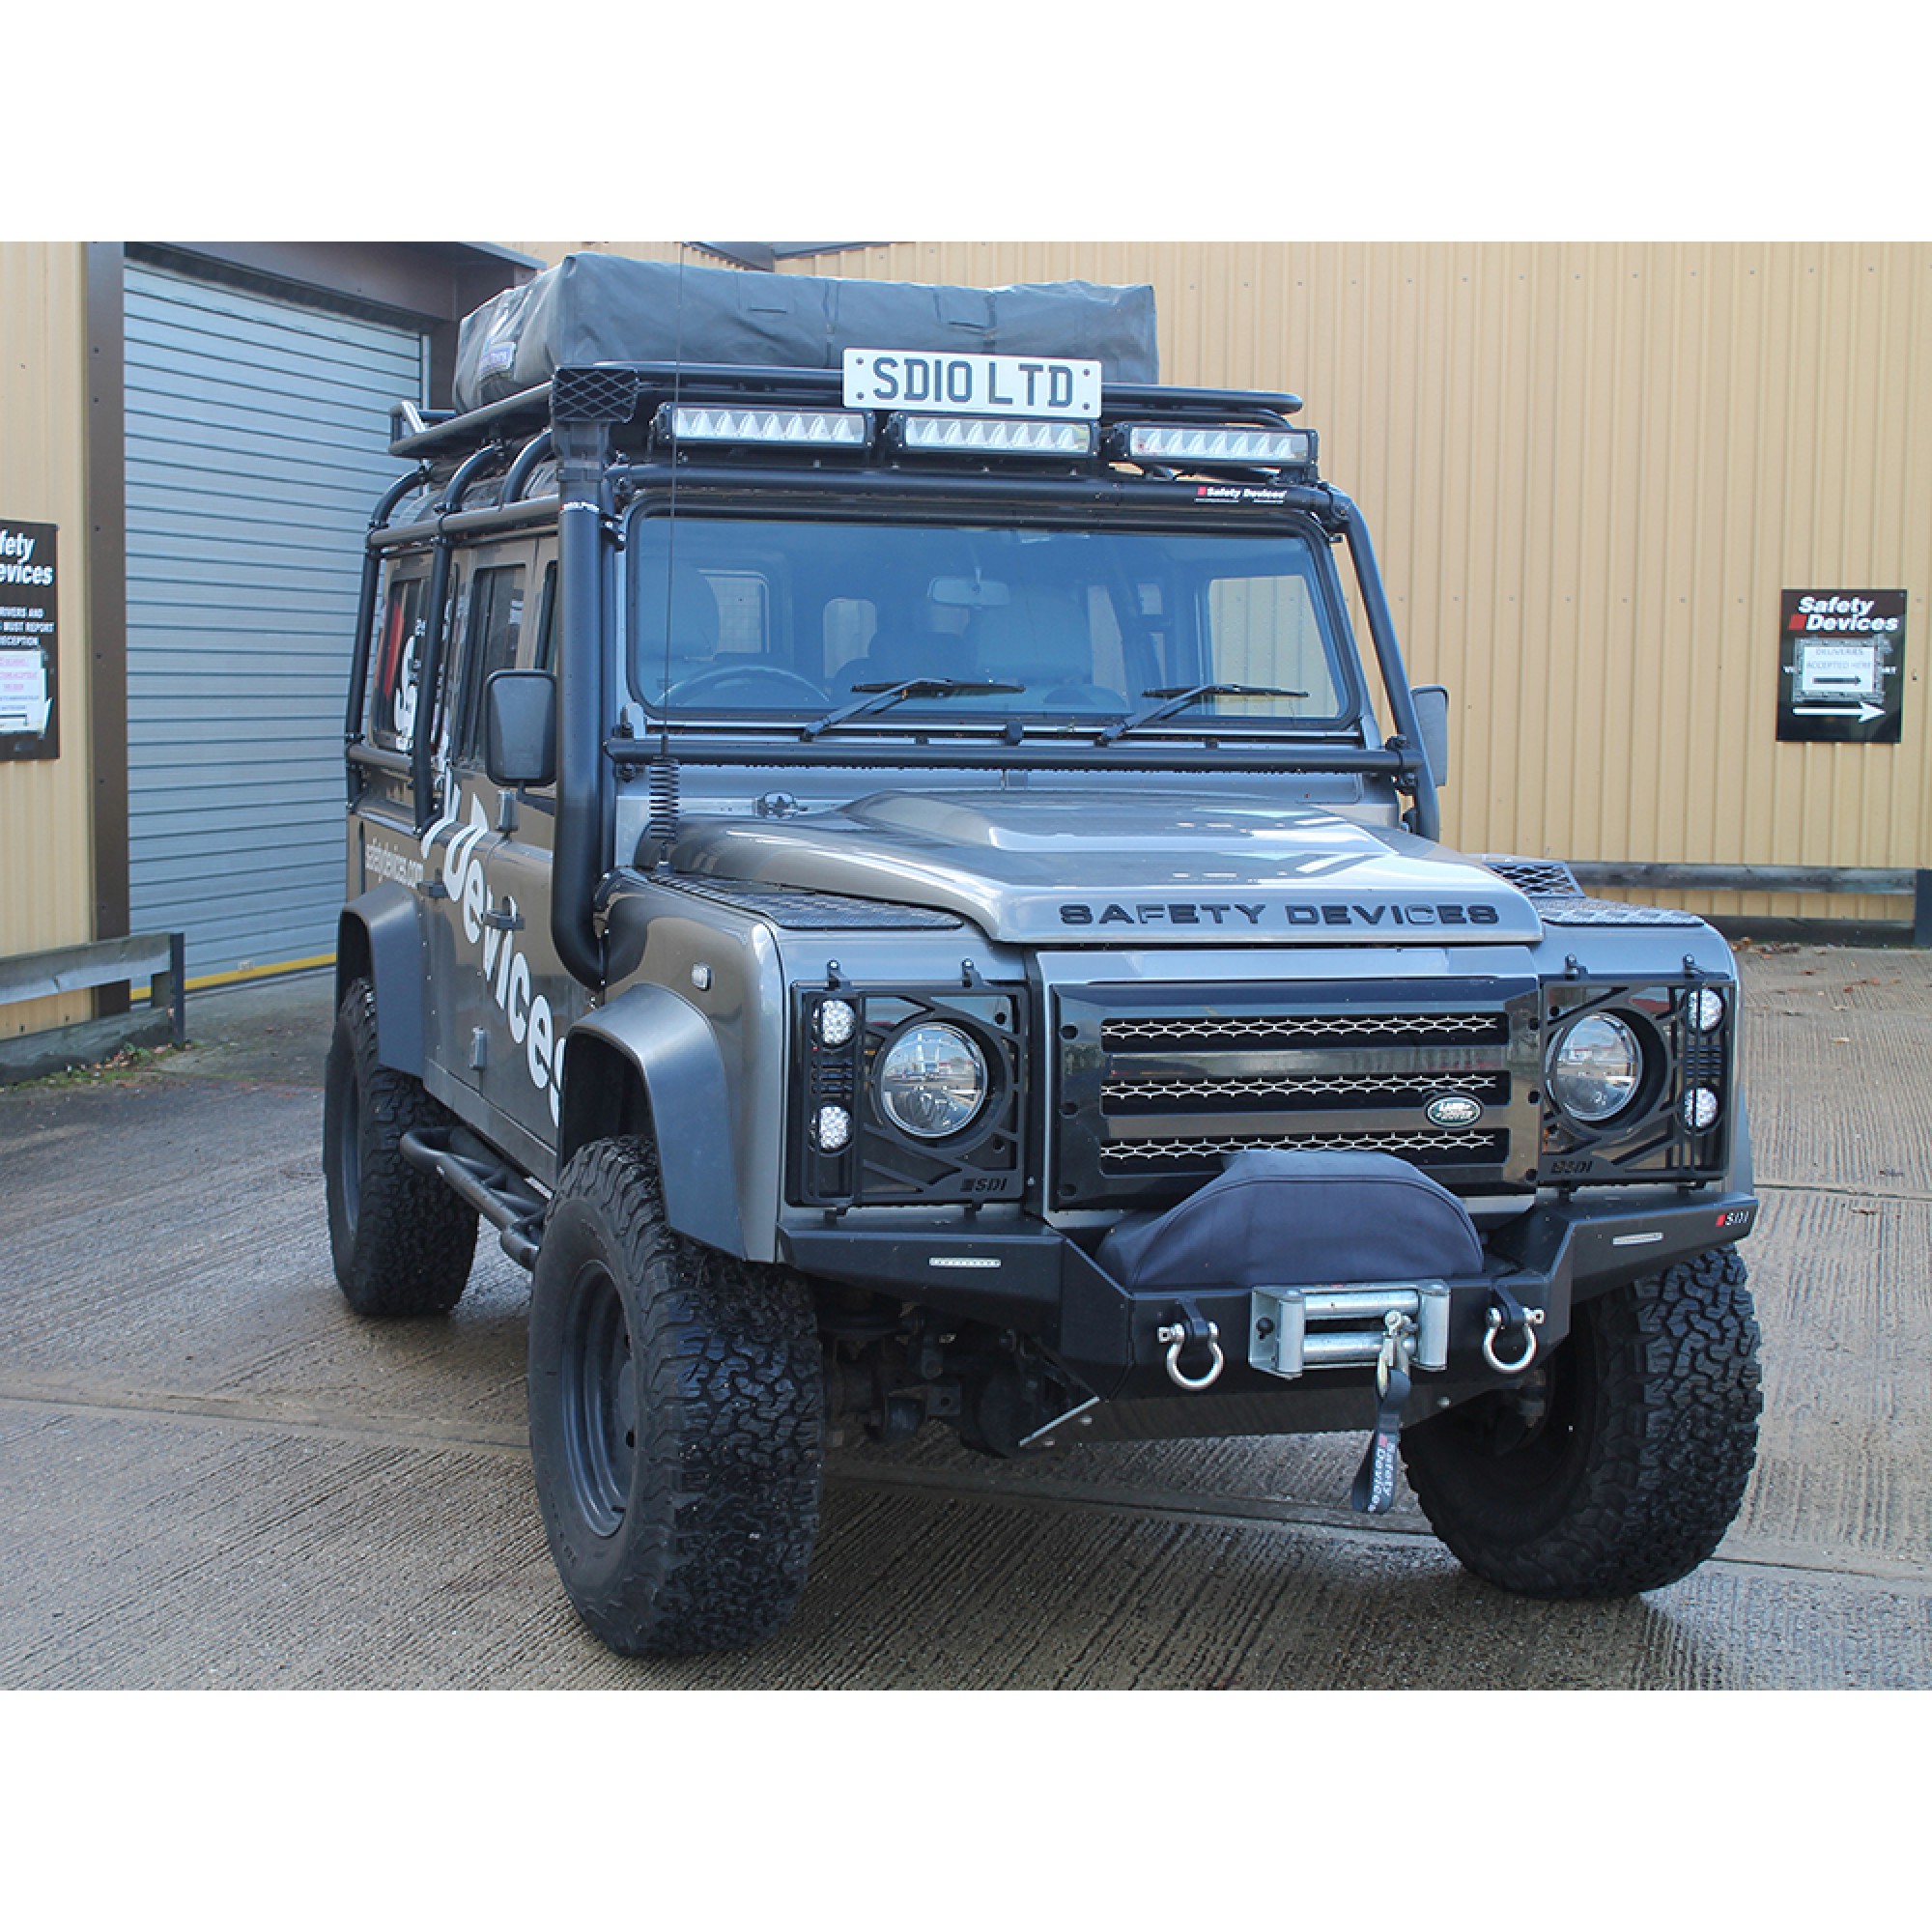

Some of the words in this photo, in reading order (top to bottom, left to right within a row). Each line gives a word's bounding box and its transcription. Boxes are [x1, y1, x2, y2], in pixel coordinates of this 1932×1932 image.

[988, 360, 1074, 409] LTD
[1207, 486, 1241, 499] Safety
[1798, 596, 1875, 617] Safety
[1805, 613, 1900, 631] Devices
[1060, 903, 1266, 925] SAFETY
[1284, 903, 1501, 925] DEVICES
[975, 1178, 1008, 1191] SDI
[1724, 1210, 1749, 1226] SDI
